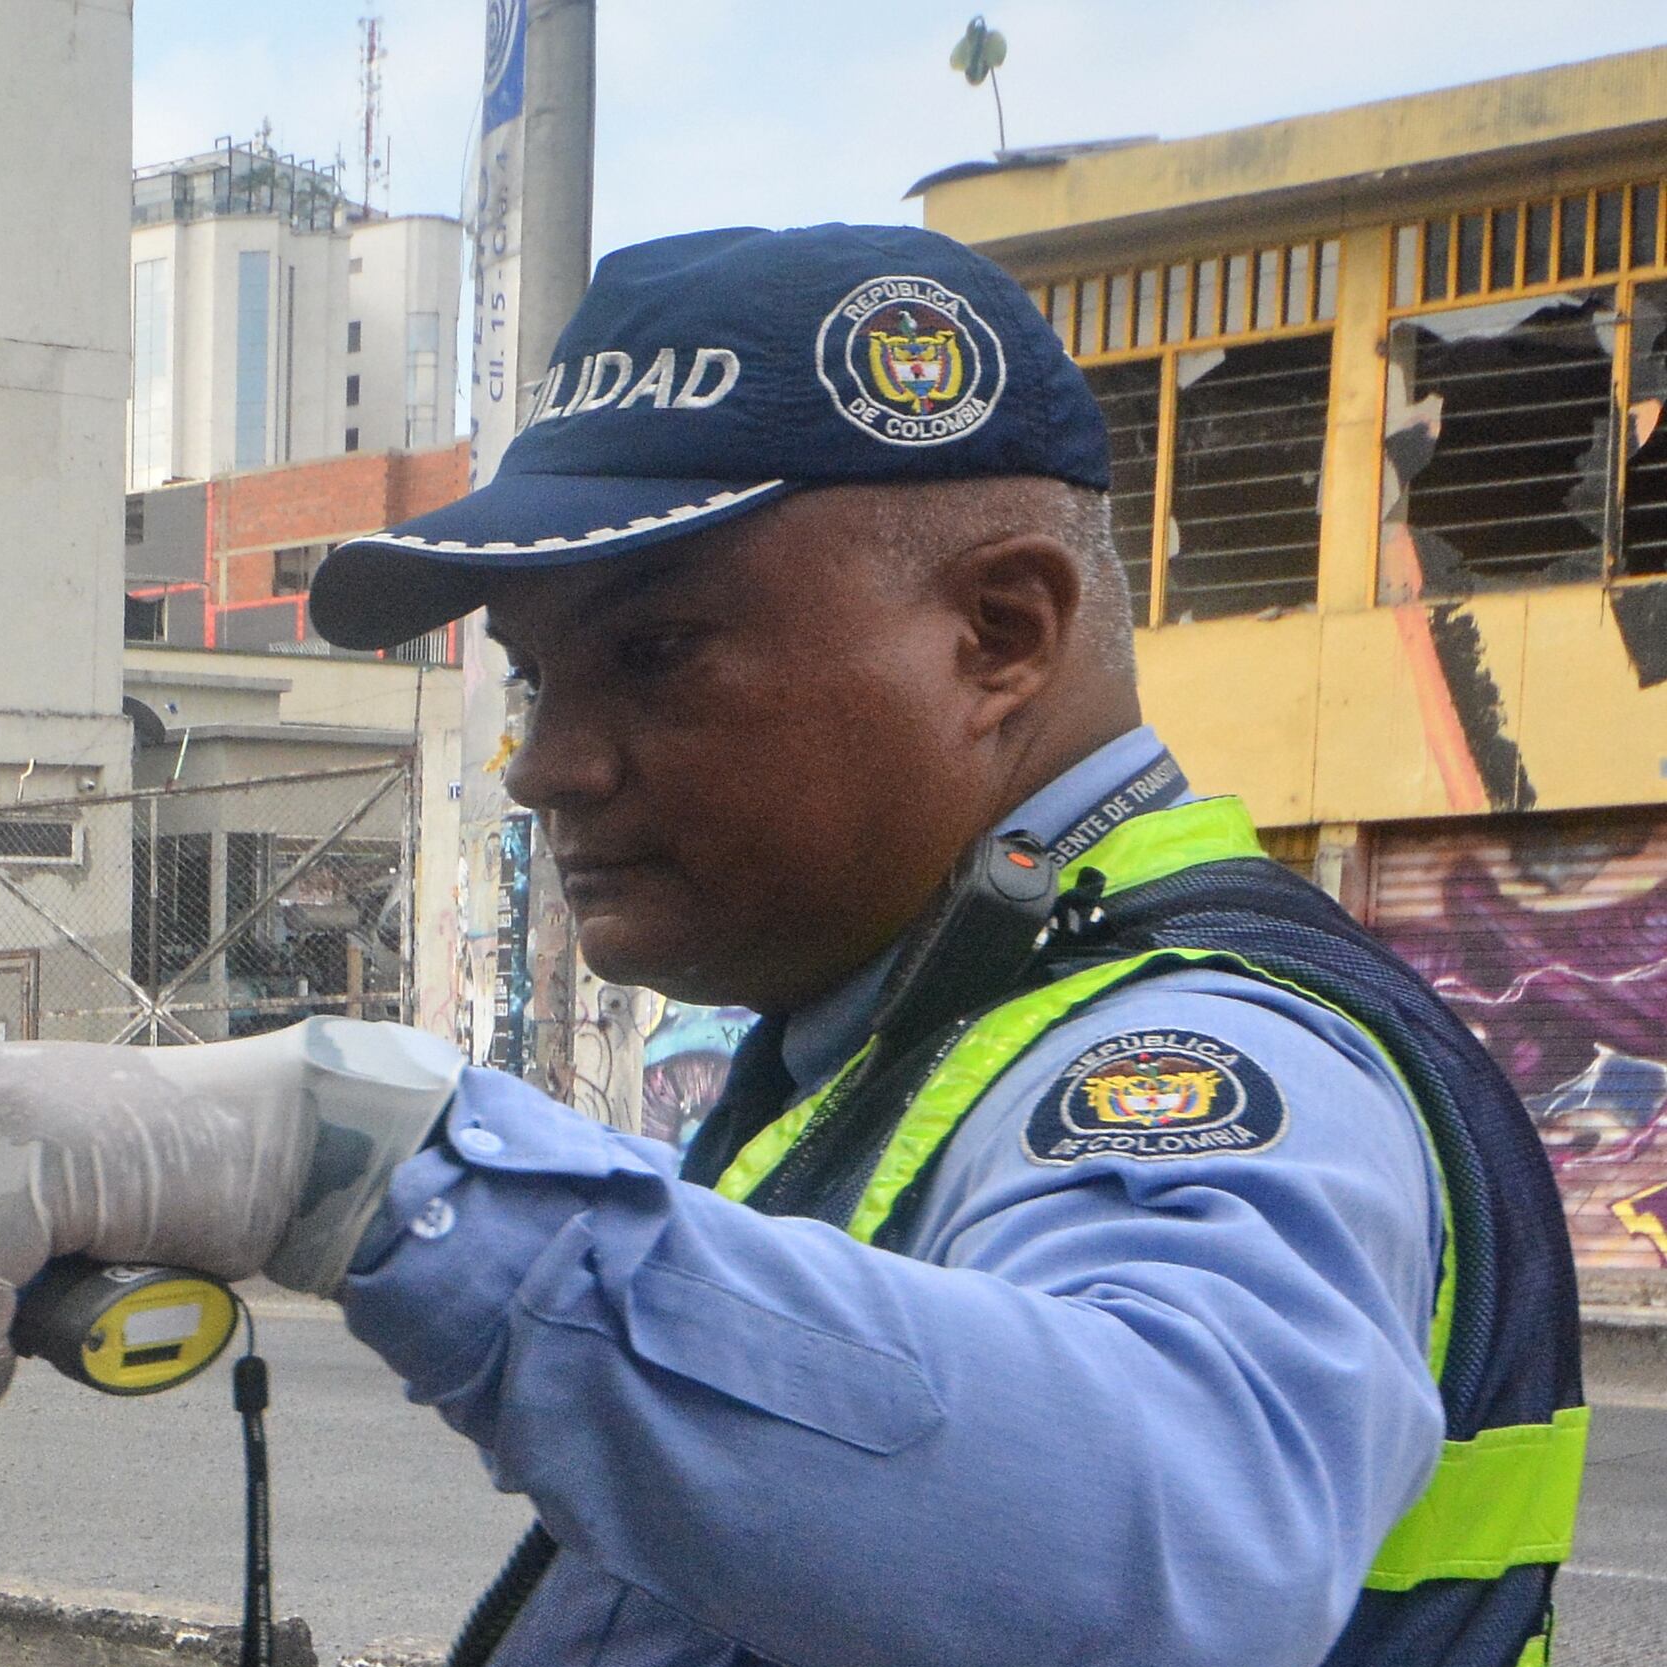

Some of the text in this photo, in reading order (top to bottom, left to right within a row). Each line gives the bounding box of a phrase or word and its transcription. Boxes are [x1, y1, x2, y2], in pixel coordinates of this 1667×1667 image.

[491, 293, 506, 332] 15
[848, 397, 988, 439] DE COLOMBIA
[1047, 814, 1110, 870] GENTE
[1102, 795, 1134, 821] DE
[1084, 1124, 1259, 1153] COLOMBIA
